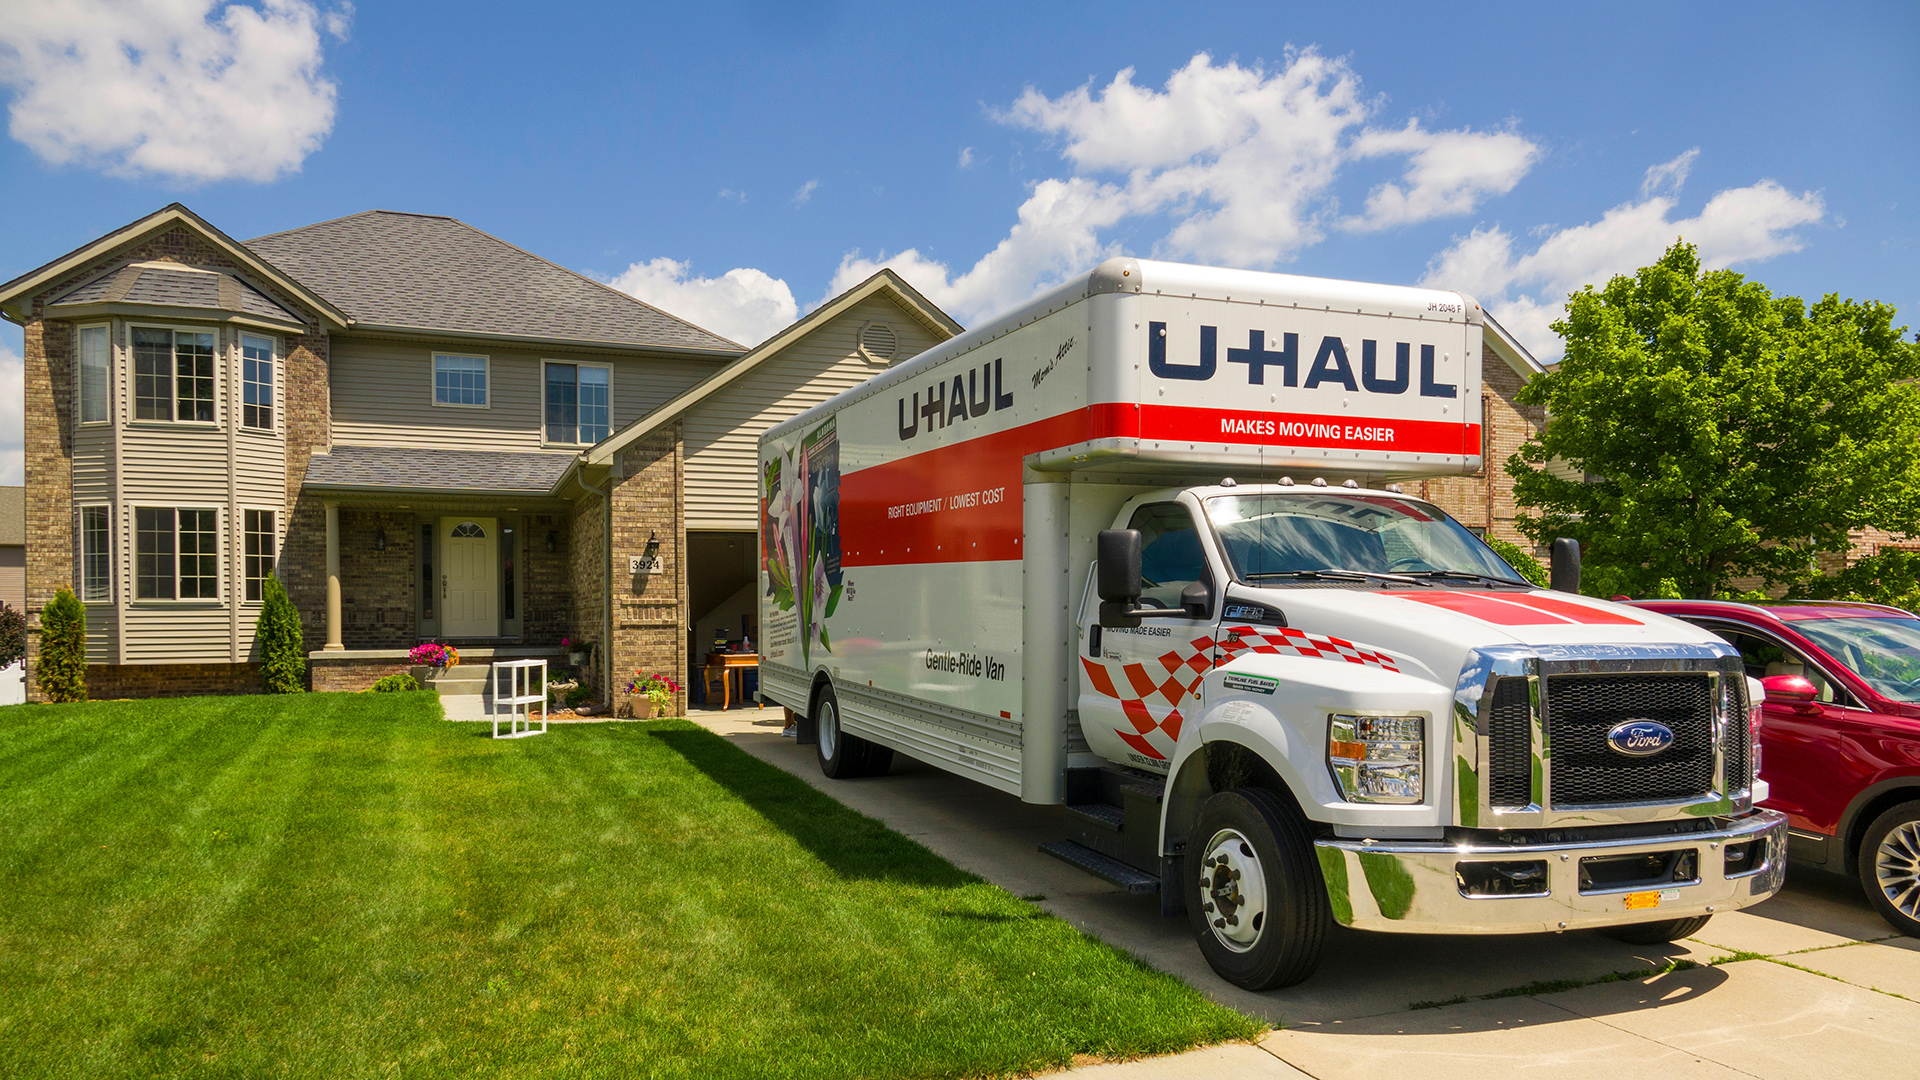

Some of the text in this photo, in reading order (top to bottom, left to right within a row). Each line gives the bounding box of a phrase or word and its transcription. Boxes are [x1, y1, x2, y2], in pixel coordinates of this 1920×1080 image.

[1427, 302, 1438, 311] JH
[1457, 305, 1462, 313] F
[1221, 418, 1395, 442] MAKES MOVING EASIER
[888, 504, 906, 519] RIGHT
[905, 498, 942, 517] EQUIPMENT
[950, 491, 981, 510] LOWEST
[982, 487, 1005, 505] COST
[632, 560, 660, 571] 3924
[1148, 628, 1172, 637] EASIER
[925, 648, 1005, 682] Gentle-Ride Van
[1625, 727, 1661, 748] Ford
